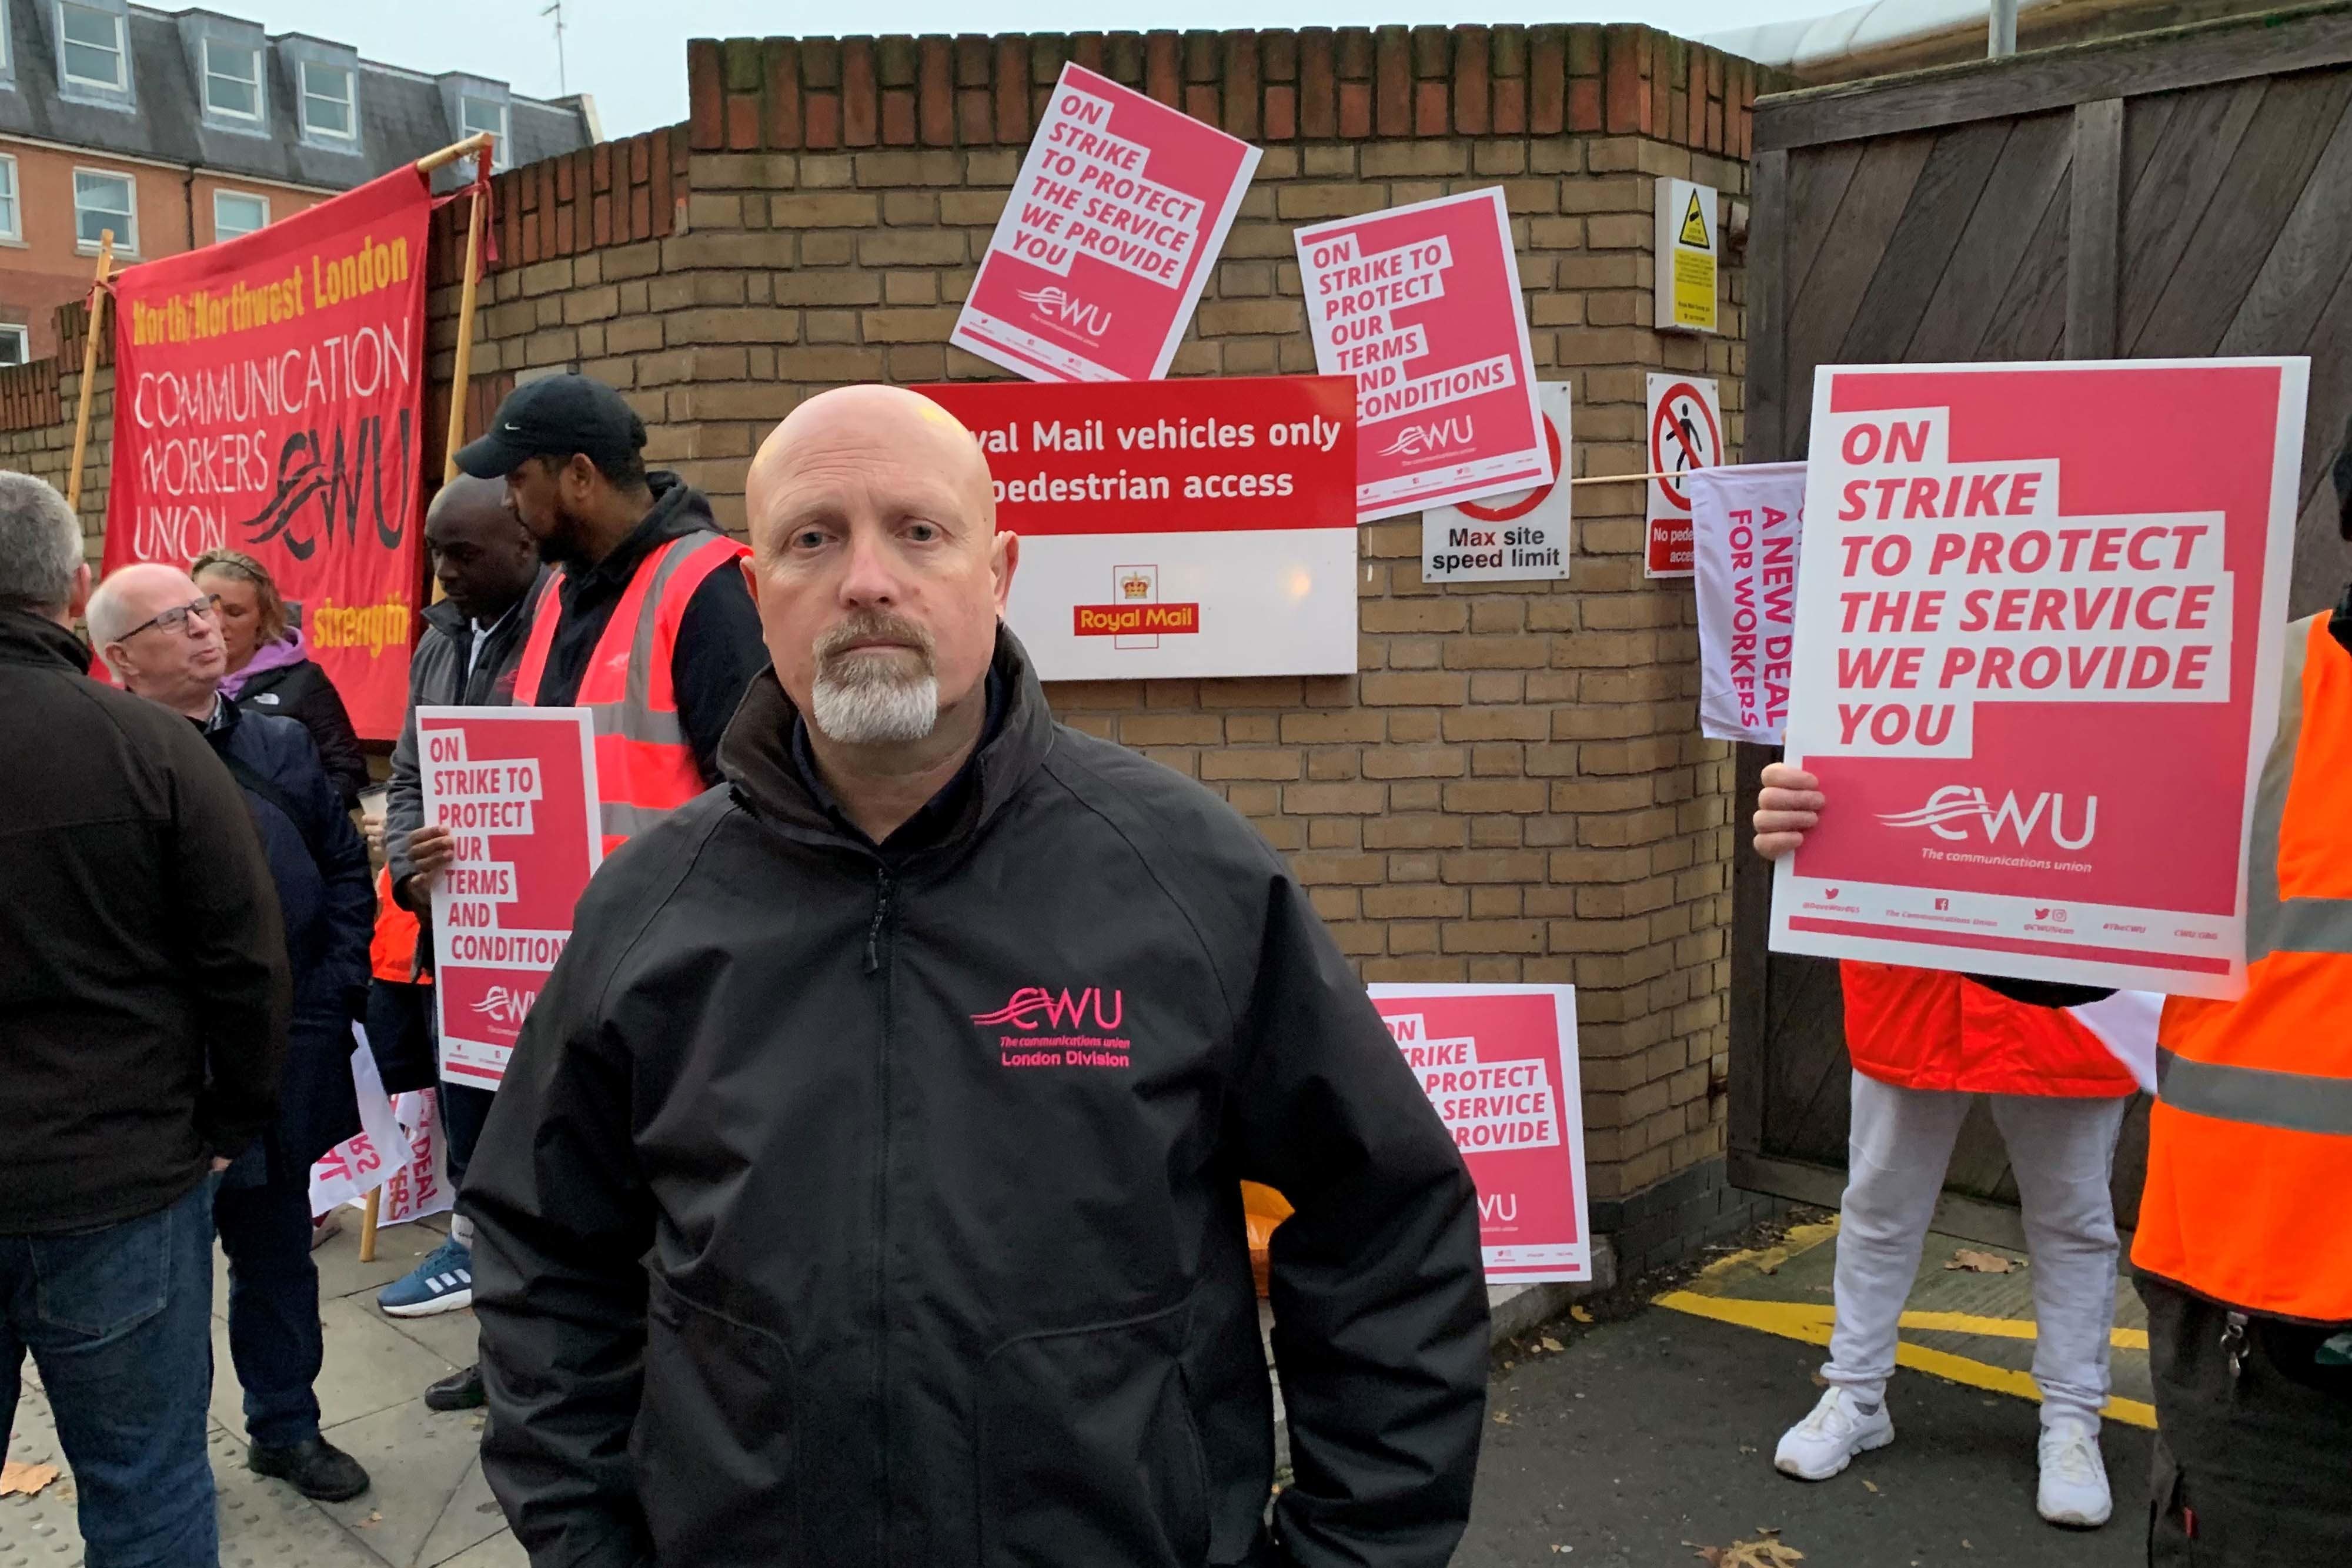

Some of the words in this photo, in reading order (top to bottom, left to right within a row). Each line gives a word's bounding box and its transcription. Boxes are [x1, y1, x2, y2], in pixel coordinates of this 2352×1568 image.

[1061, 95, 1104, 125] ON
[1049, 123, 1141, 170] STRIKE
[1041, 148, 1076, 176] TO
[1079, 168, 1197, 223] PROTECT
[1031, 176, 1083, 210] THE
[1083, 197, 1190, 252] SERVICE
[1012, 230, 1068, 266] YOU
[1021, 202, 1064, 233] WE
[1064, 222, 1179, 279] PROVIDE
[1314, 241, 1351, 269] ON
[1318, 253, 1402, 295] STRIKE
[1409, 243, 1442, 269] TO
[132, 267, 305, 347] North/Northwest
[312, 235, 409, 310] London
[1016, 286, 1112, 336] CWU
[1326, 273, 1435, 321] PROTECT
[1331, 315, 1384, 346] OUR
[1336, 331, 1418, 372] TERMS
[135, 317, 410, 429] COMMUNICATION
[1357, 366, 1396, 394] ND
[1033, 420, 1104, 452] Mail
[1117, 417, 1255, 451] vehicles
[1269, 414, 1341, 451] only
[1375, 414, 1474, 457] CWU
[1841, 421, 1931, 465] ON
[141, 429, 268, 497] WORKERS
[241, 408, 410, 562] CWU
[1184, 473, 1294, 499] access
[1838, 472, 2042, 521] STRIKE
[133, 505, 226, 563] UNION
[1448, 527, 1496, 547] Max
[1503, 527, 1545, 546] site
[1653, 527, 1668, 541] No
[1761, 506, 1788, 530] A
[1432, 550, 1504, 572] speed
[1511, 547, 1560, 568] limit
[1729, 509, 1753, 573] FOR
[1841, 534, 1912, 578] TO
[1929, 524, 2209, 576] PROTECT
[1762, 536, 1793, 624] NEW
[312, 591, 409, 660] strength
[1080, 608, 1140, 631] Royal
[1146, 607, 1192, 627] Mail
[1839, 590, 1946, 633] THE
[1959, 585, 2214, 631] SERVICE
[1730, 576, 1759, 728] WORKERS
[1838, 647, 1932, 690] WE
[1939, 646, 2213, 690] PROVIDE
[1763, 635, 1792, 727] DEAL
[1838, 704, 1955, 745] YOU
[430, 736, 459, 763] ON
[434, 768, 500, 795] STRIKE
[507, 767, 534, 793] TO
[438, 801, 524, 828] PROTECT
[1873, 784, 2099, 850] CWU
[457, 836, 482, 861] UR
[1921, 847, 1943, 861] The
[1946, 852, 2051, 870] communications
[2054, 861, 2092, 873] union
[445, 870, 509, 894] TERMS
[448, 902, 490, 927] AND
[452, 935, 568, 964] CONDITION
[970, 987, 1122, 1029] CWU
[1000, 1036, 1017, 1047] The
[1019, 1035, 1101, 1047] communications
[1103, 1038, 1130, 1049] union
[1002, 1051, 1061, 1066] London
[1065, 1051, 1130, 1068] Division
[1425, 1065, 1539, 1094] PROTECT
[1444, 1092, 1546, 1120] SERVICE
[1447, 1120, 1549, 1148] ROVIDE
